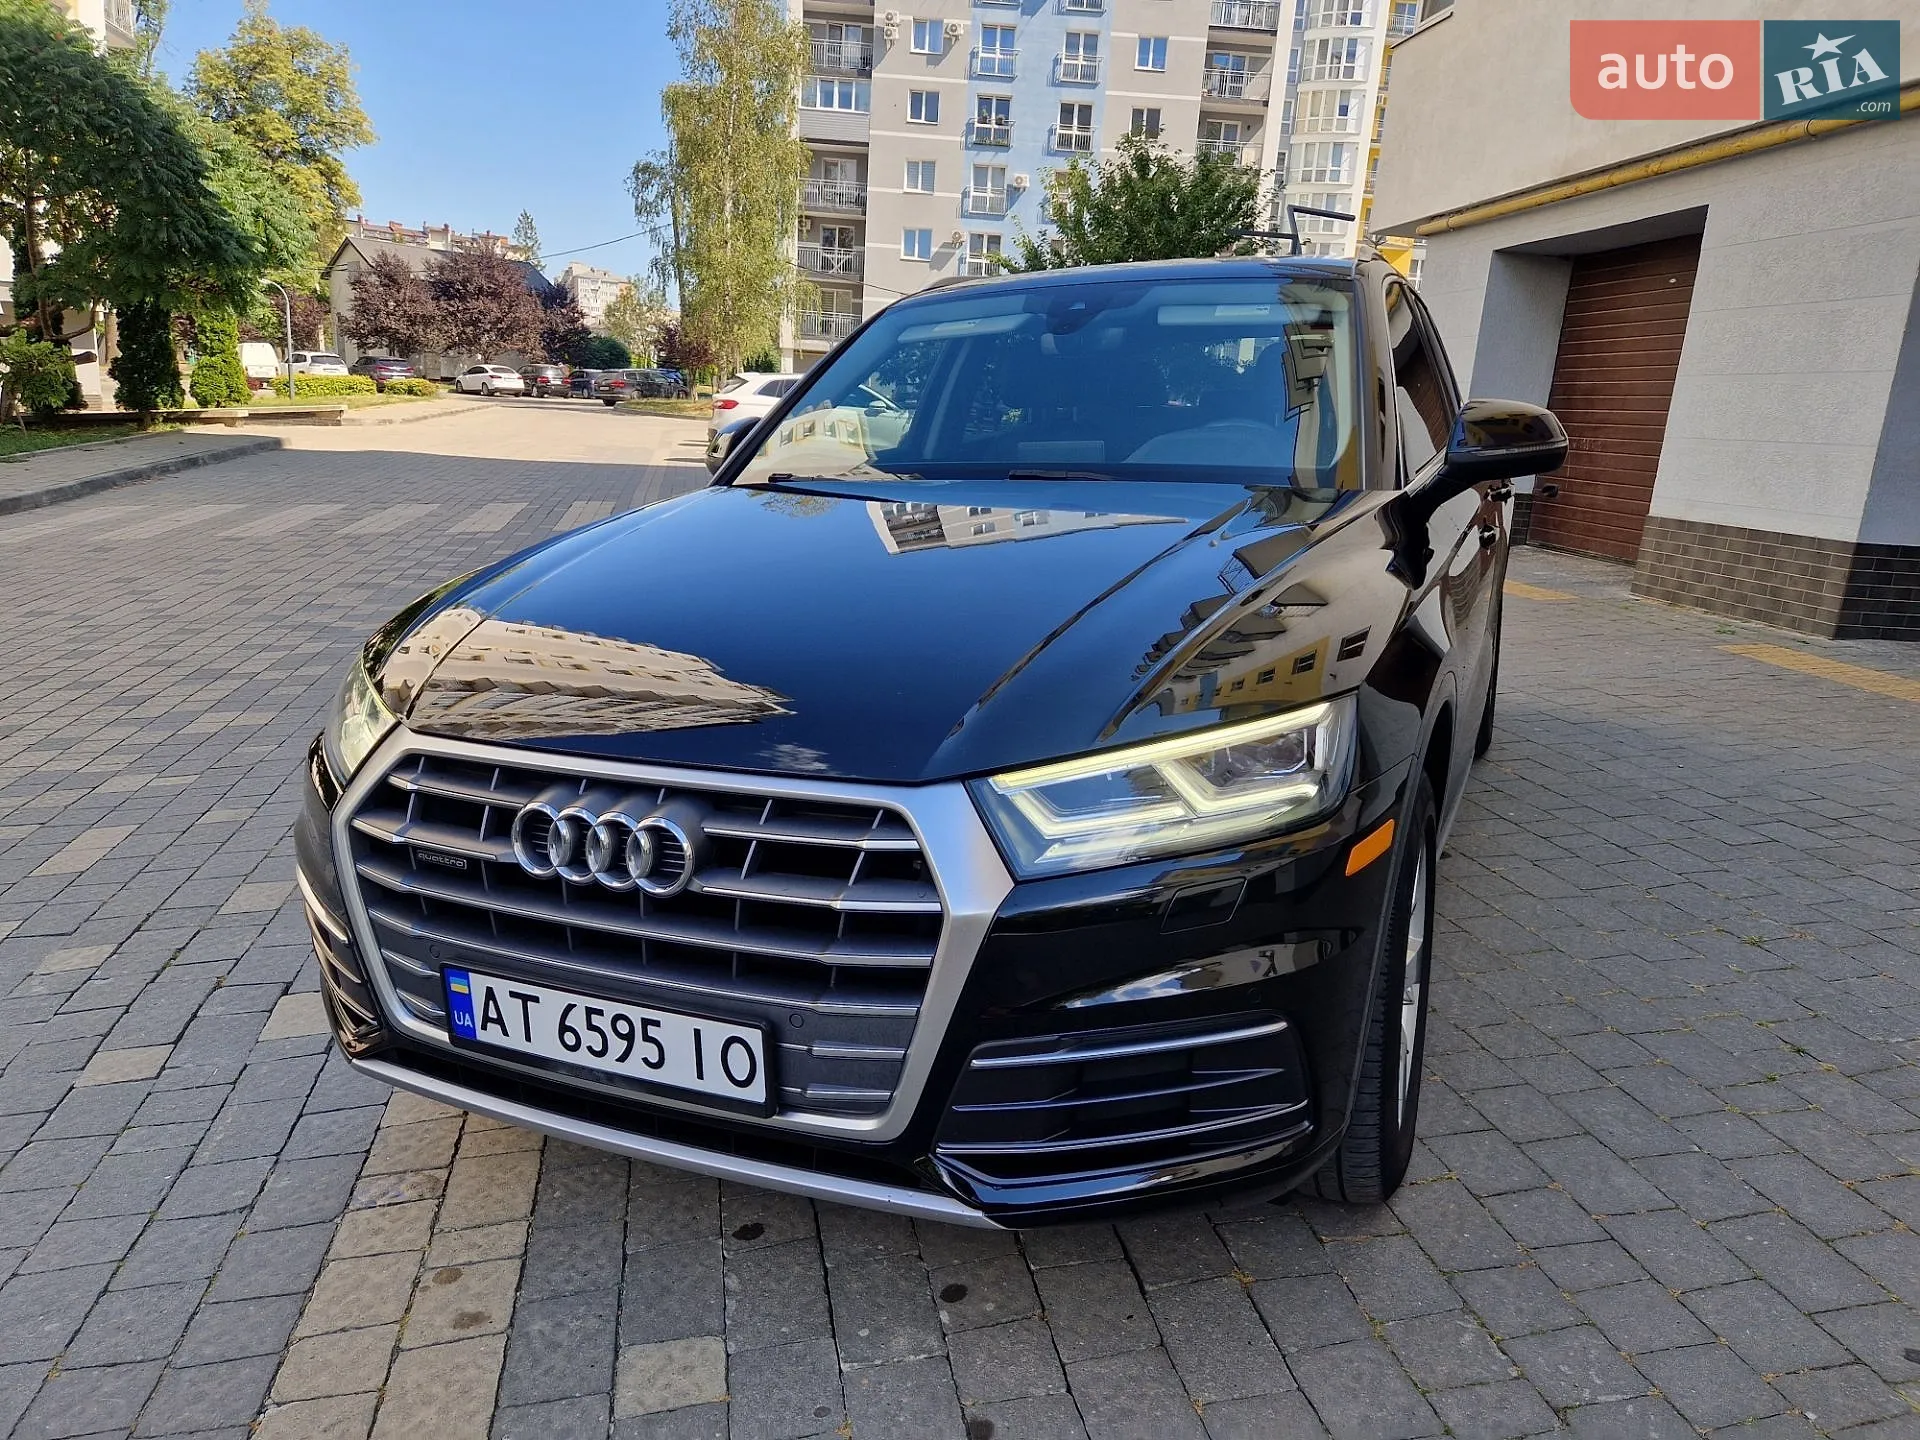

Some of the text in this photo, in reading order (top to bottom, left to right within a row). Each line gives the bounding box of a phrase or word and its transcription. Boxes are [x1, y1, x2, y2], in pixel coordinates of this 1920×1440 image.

[418, 852, 464, 867] quattro
[454, 1010, 473, 1028] UA
[480, 985, 540, 1043] AT
[558, 1003, 666, 1070] 6595
